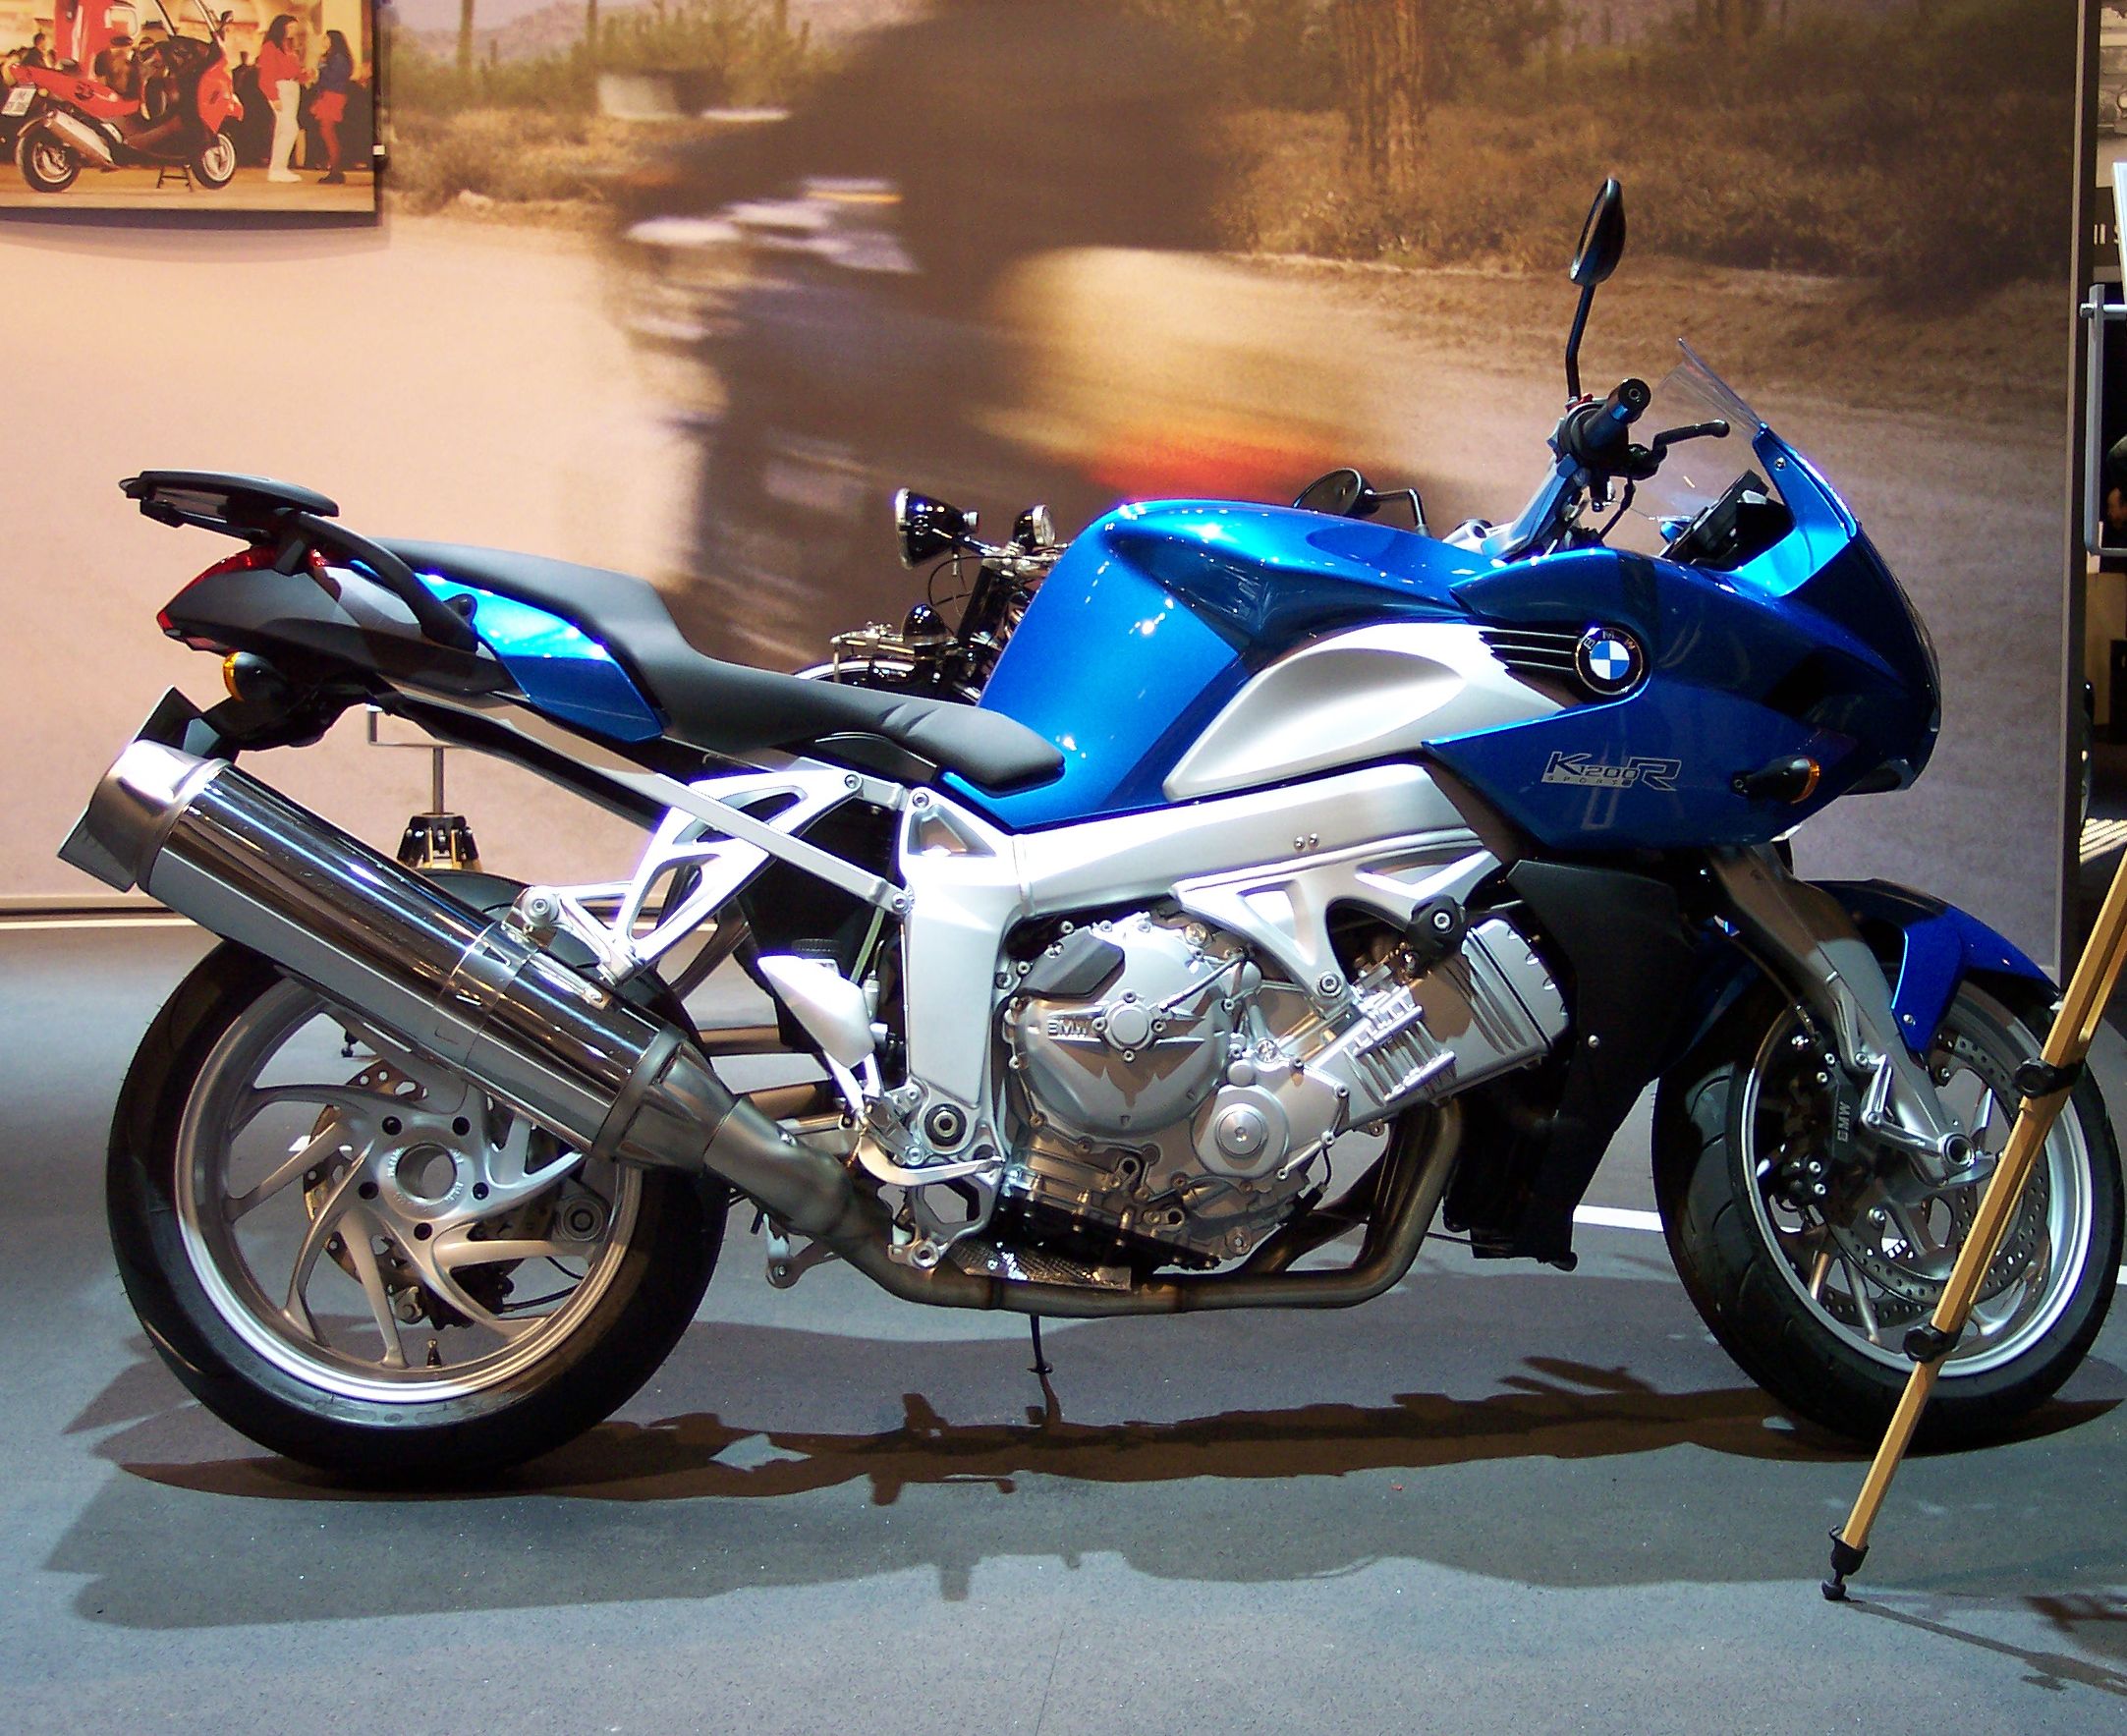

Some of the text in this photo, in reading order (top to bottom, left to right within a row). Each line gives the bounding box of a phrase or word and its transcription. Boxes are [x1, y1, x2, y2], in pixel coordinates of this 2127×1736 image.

[1583, 630, 1636, 650] BMW
[1047, 1019, 1088, 1036] BMW
[1837, 1100, 1851, 1143] BMW
